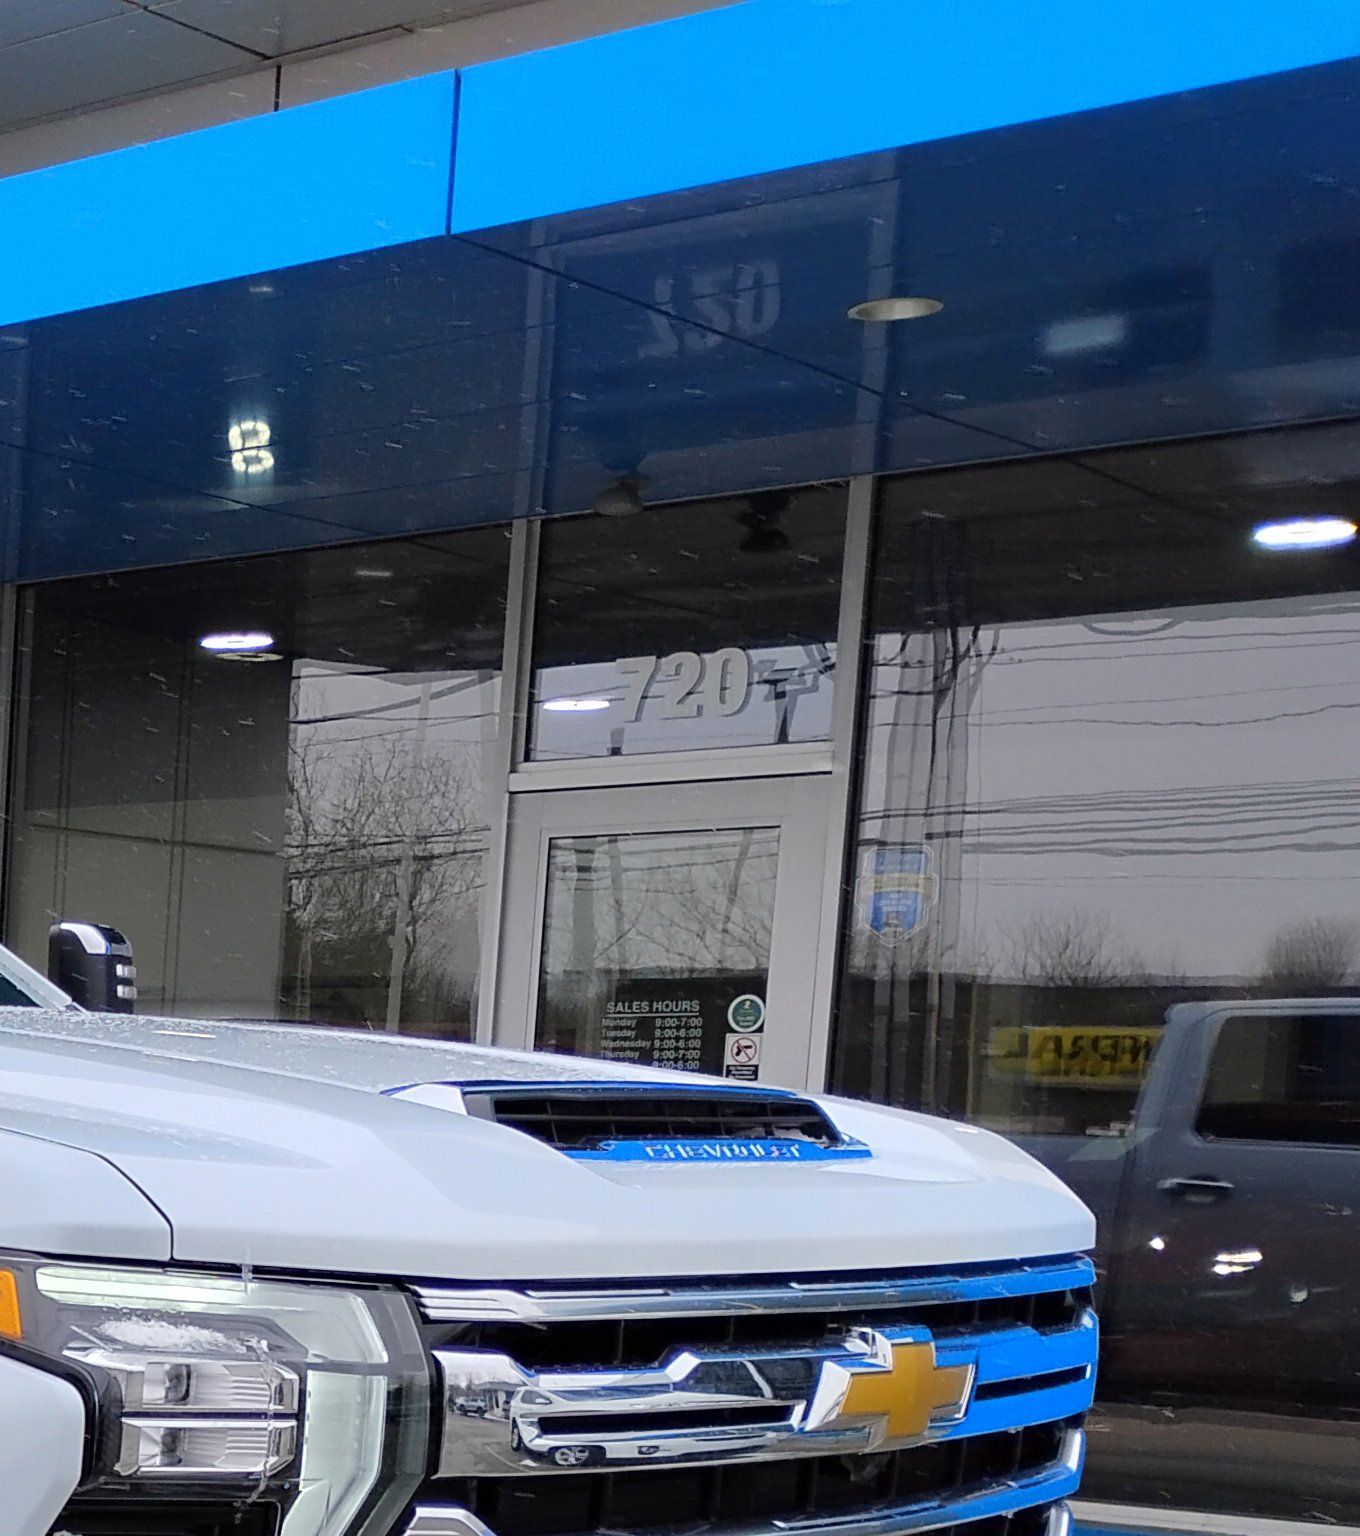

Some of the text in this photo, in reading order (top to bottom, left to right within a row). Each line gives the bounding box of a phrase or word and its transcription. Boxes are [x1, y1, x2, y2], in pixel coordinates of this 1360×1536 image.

[616, 648, 751, 723] 720
[607, 1000, 700, 1013] SALES HOURS
[602, 1017, 702, 1029] Monday 9:00-7:00
[602, 1028, 702, 1039] Tuesday 9:00-6:00
[600, 1038, 701, 1049] Wednesday 9:00-6:00
[653, 1049, 700, 1059] 9:00-7:00
